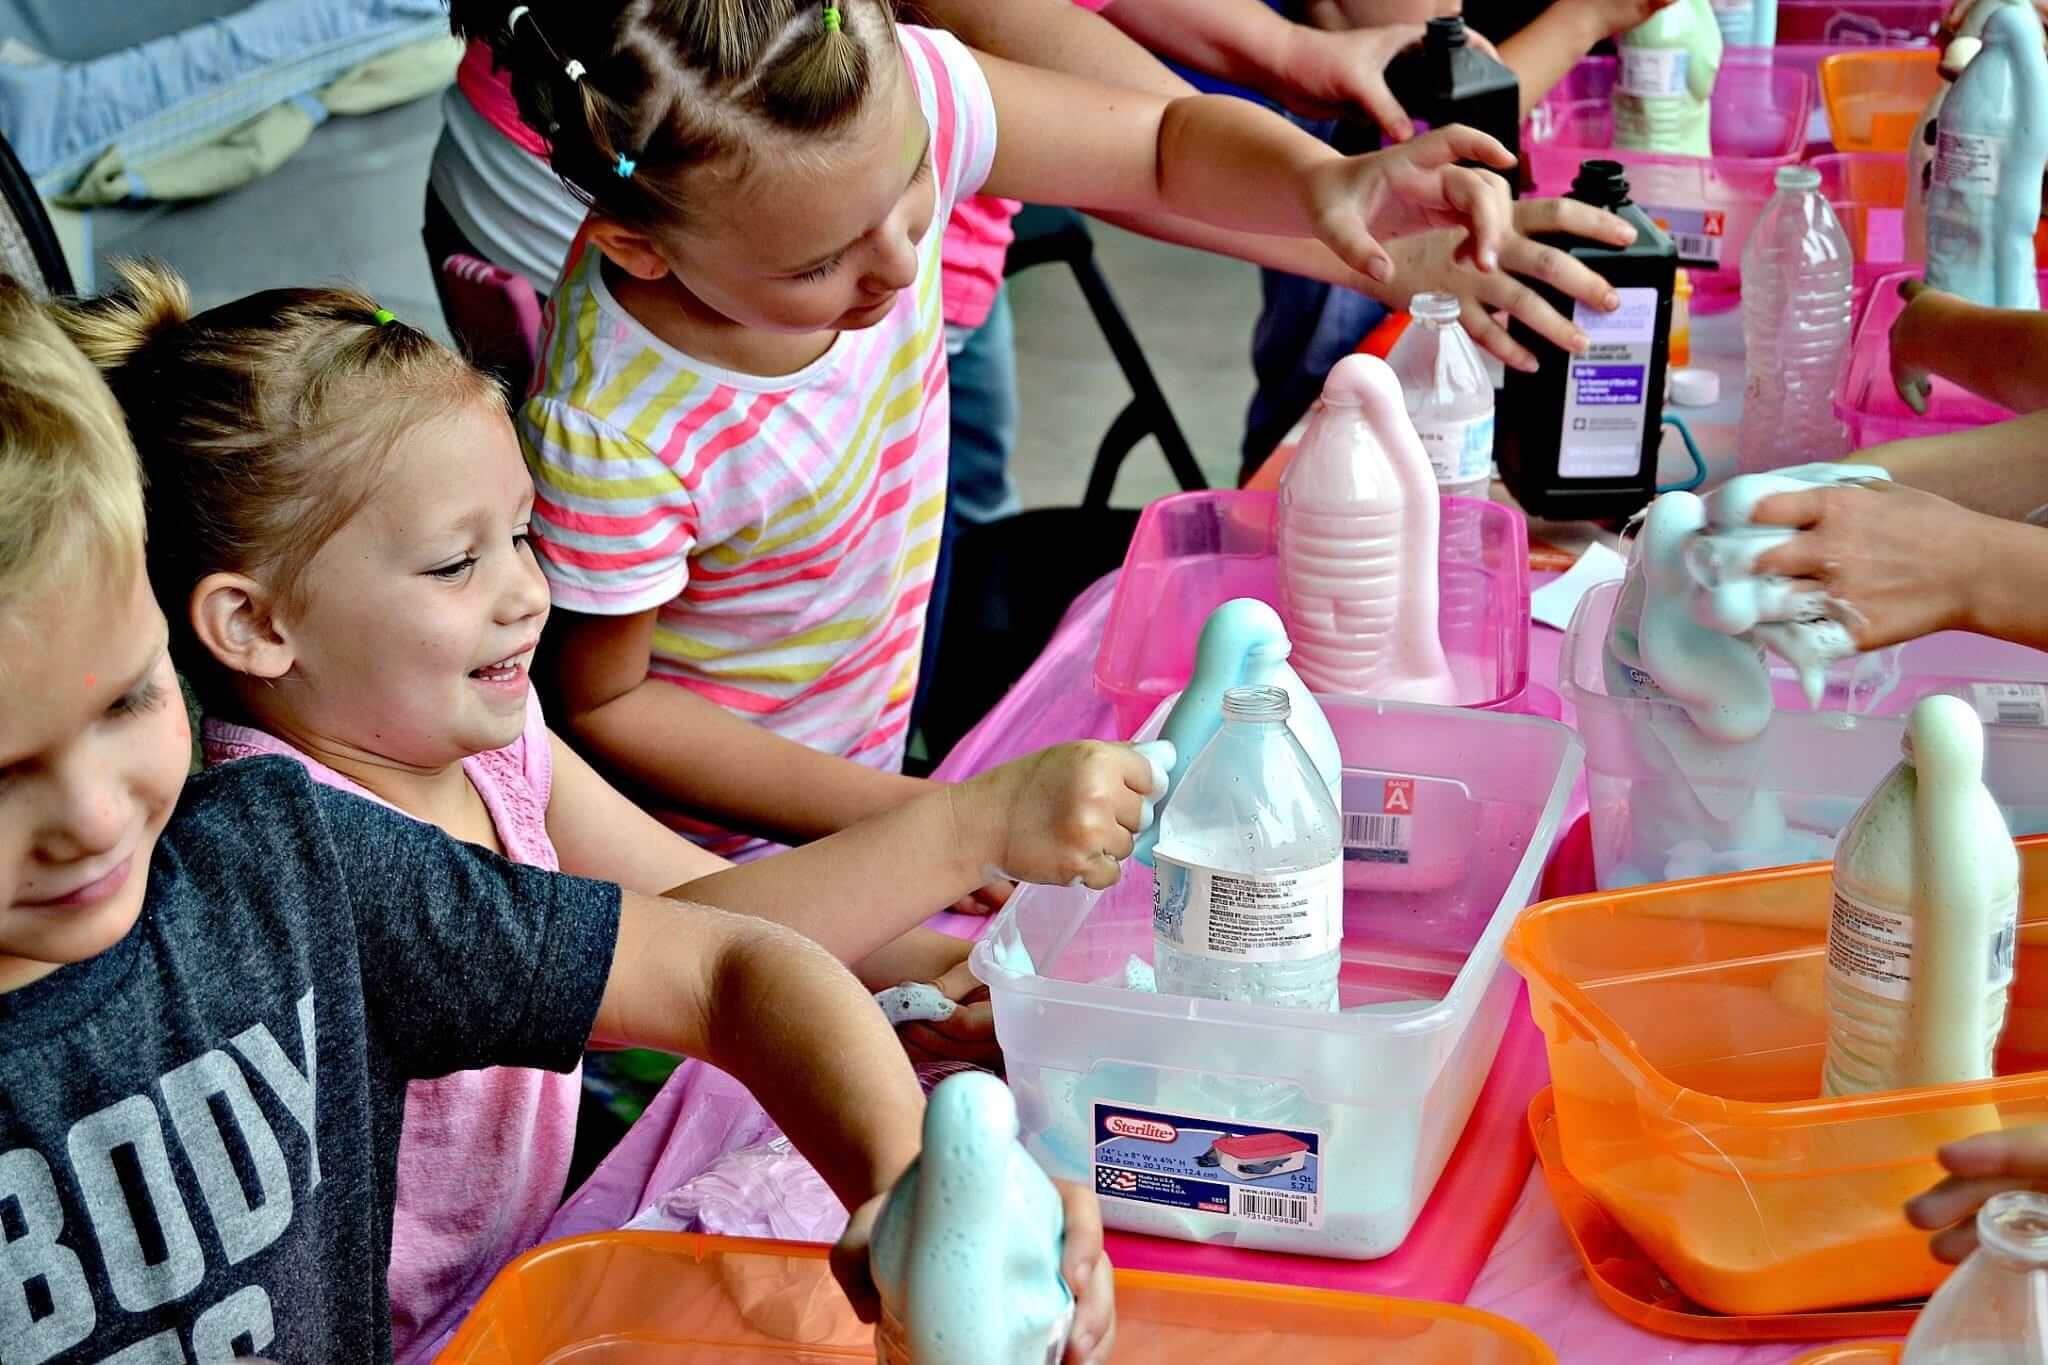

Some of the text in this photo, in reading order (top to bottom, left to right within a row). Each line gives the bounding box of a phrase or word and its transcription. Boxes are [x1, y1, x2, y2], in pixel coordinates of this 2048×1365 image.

[1386, 787, 1409, 810] A
[1112, 1119, 1169, 1139] Sterilite
[0, 986, 322, 1365] BODY
[1290, 1173, 1297, 1181] 6
[1239, 1188, 1307, 1201] www.sterilite.com
